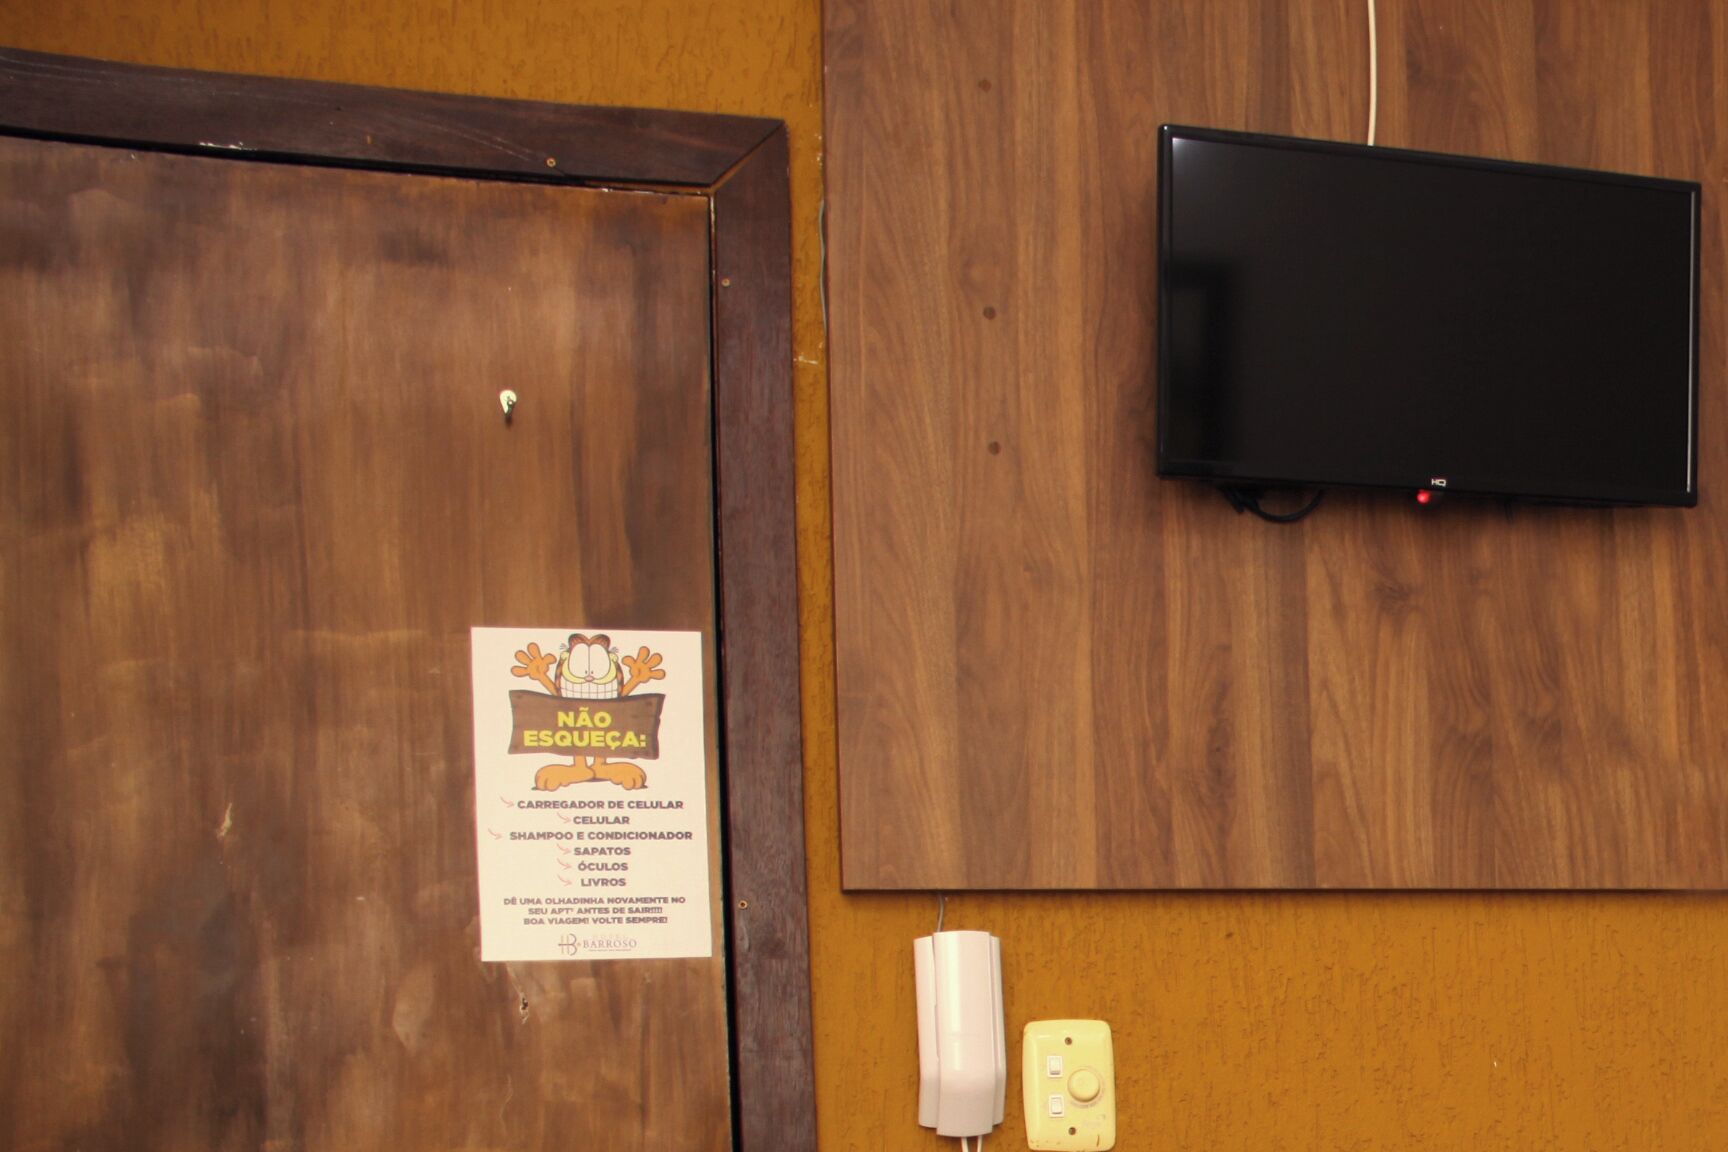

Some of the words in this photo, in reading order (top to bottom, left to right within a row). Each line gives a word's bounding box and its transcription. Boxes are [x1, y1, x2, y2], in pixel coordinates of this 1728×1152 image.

[1431, 478, 1447, 487] HQ
[557, 707, 612, 728] NÃO
[523, 730, 647, 750] ESQUEÇA:
[517, 800, 605, 809] CARREGADOR
[608, 800, 624, 809] DE
[627, 800, 684, 809] CELULAR
[573, 815, 630, 825] CELULAR
[509, 831, 574, 840] SHAMPOO
[577, 831, 585, 840] E
[587, 831, 693, 840] CONDICIONADOR
[573, 847, 632, 856] SAPATOS
[577, 860, 629, 871] ÓCULOS
[580, 878, 627, 887] LIVROS
[519, 897, 542, 905] UMA
[545, 897, 604, 905] OLHADINHA
[607, 896, 669, 904] NOVAMENTE
[671, 896, 686, 904] NO
[577, 907, 610, 915] ANTES
[583, 939, 637, 948] BARROSO
